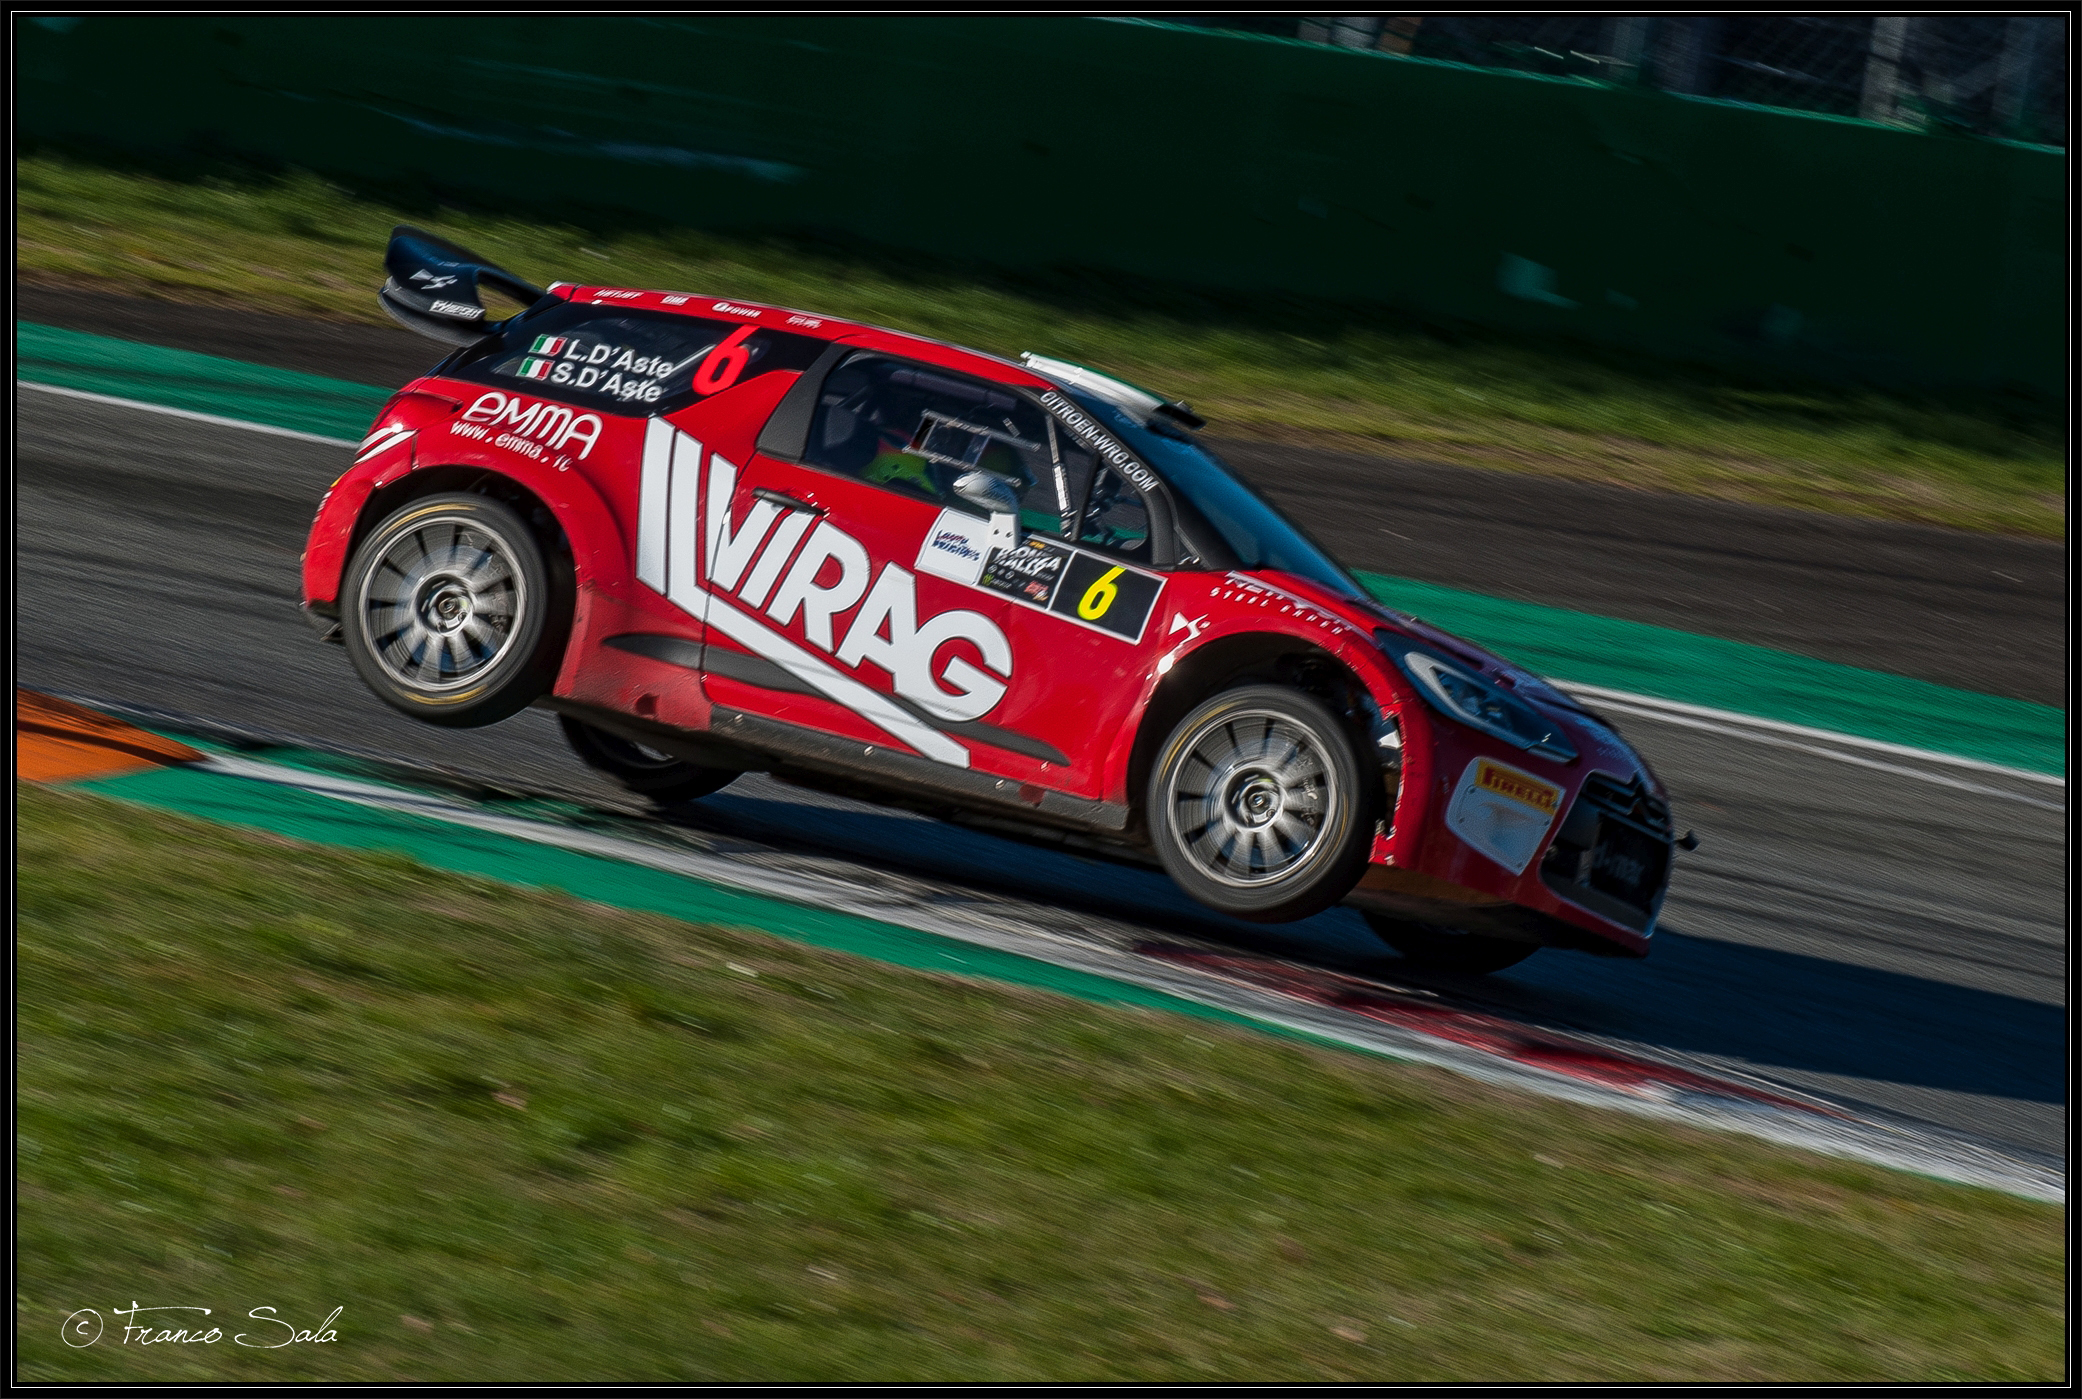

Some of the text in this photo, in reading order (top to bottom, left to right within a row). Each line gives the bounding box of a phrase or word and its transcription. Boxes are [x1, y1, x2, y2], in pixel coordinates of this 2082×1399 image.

[550, 361, 664, 402] S.D'Aste
[562, 338, 675, 379] L.D'Aste
[692, 323, 761, 396] 6
[705, 451, 1013, 722] VIRAG
[1077, 564, 1127, 620] 6
